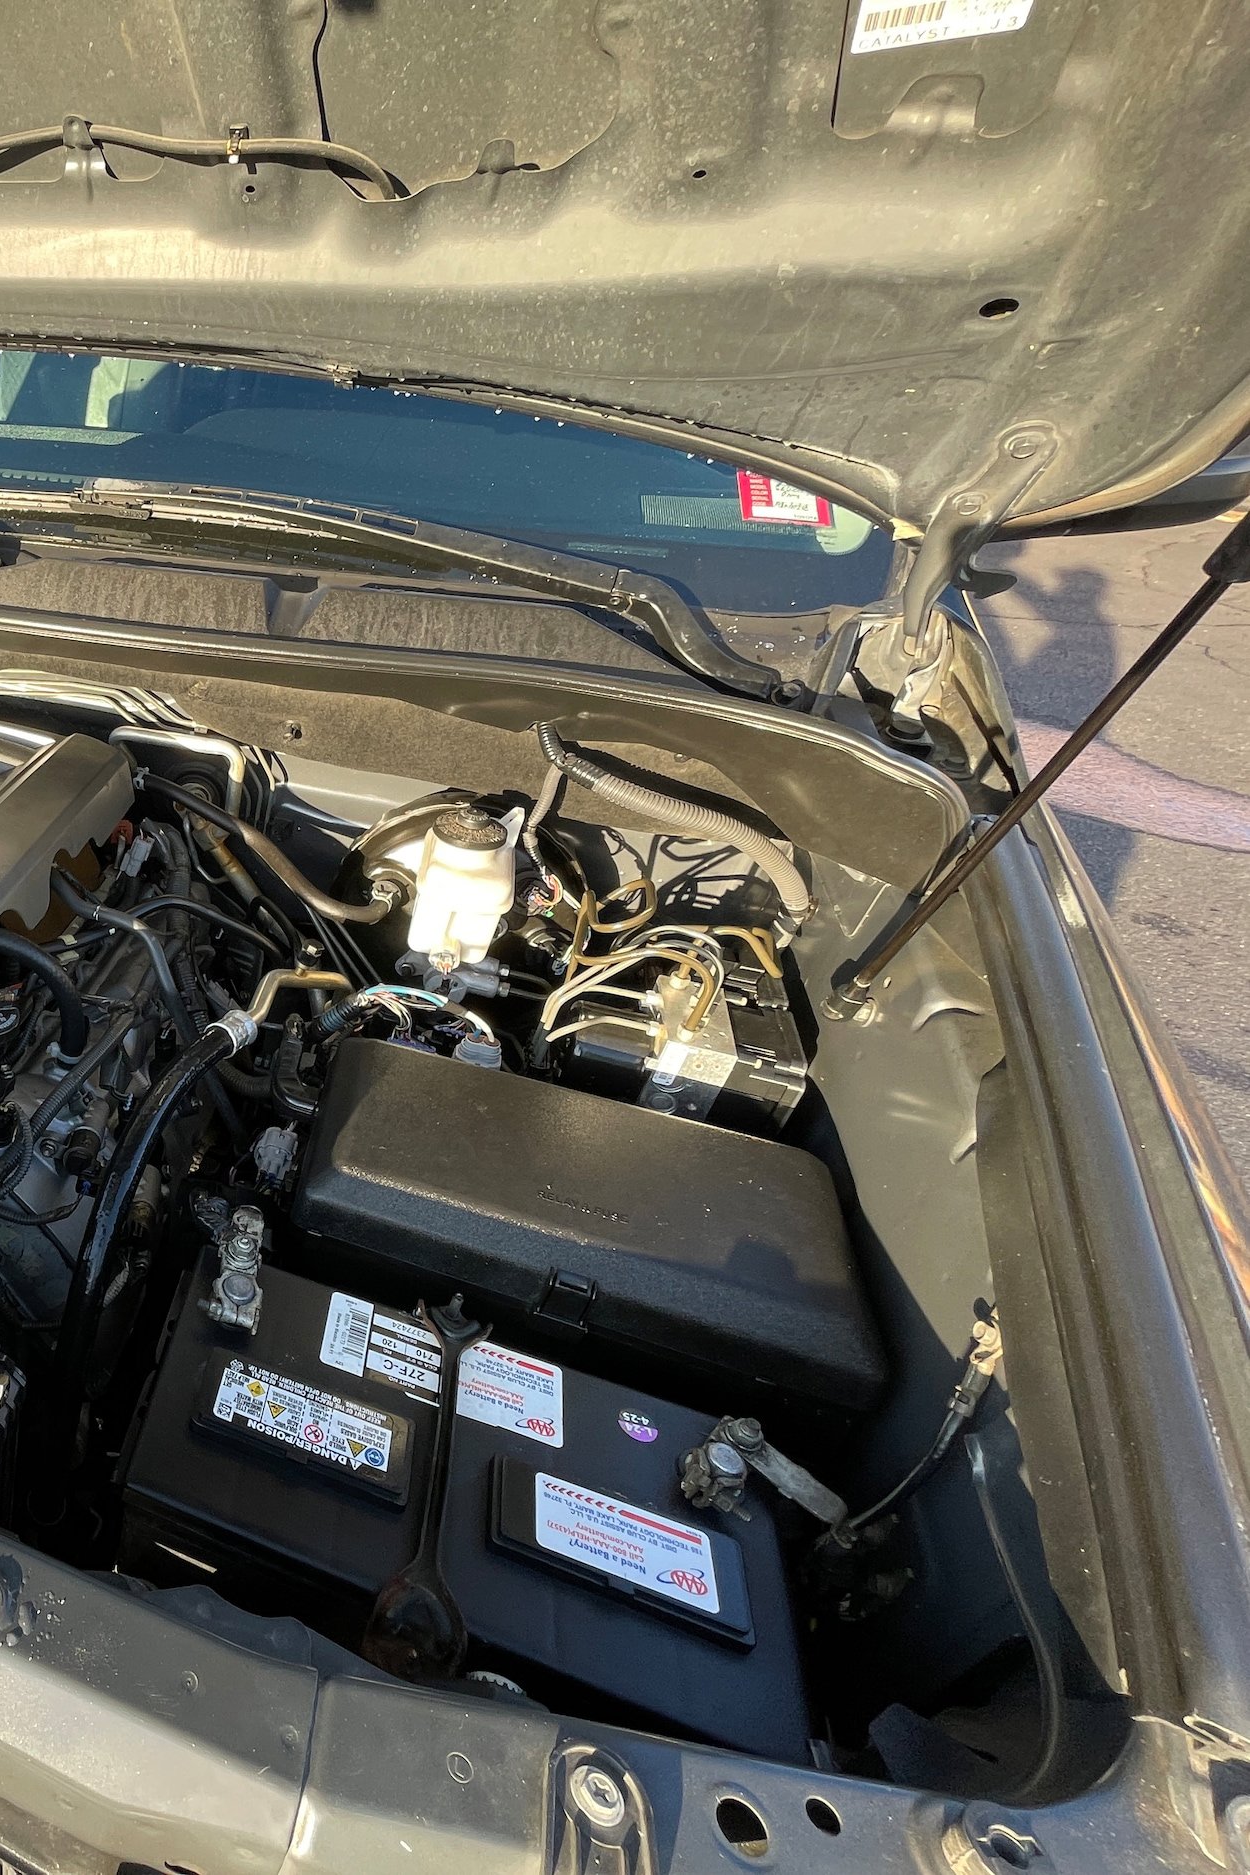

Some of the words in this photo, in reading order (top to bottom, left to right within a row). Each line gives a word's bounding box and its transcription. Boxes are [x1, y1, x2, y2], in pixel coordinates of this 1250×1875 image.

[859, 26, 950, 50] CATALYST
[391, 1320, 426, 1339] 2377424
[381, 1337, 398, 1349] 120
[395, 1332, 417, 1344] SERIAL
[415, 1348, 433, 1361] 710
[382, 1357, 425, 1382] 27F-C
[423, 1362, 437, 1371] CCA
[495, 1367, 540, 1386] TECHNOLOGY
[535, 1375, 553, 1386] LAKE
[464, 1387, 495, 1404] Battery?
[470, 1377, 523, 1400] AAA.com/battery
[504, 1402, 523, 1414] Need
[511, 1398, 523, 1406] Call
[530, 1418, 550, 1437] AAA
[246, 1418, 347, 1465] DANGER/POISON
[564, 1498, 571, 1507] FL
[596, 1510, 614, 1523] LAKE
[600, 1519, 624, 1533] ASSIST
[575, 1520, 643, 1554] AAA.com/battery
[626, 1528, 646, 1541] CLUB
[639, 1526, 689, 1551] TECHNOLOGY
[569, 1535, 608, 1560] Battery?
[611, 1553, 617, 1561] a
[628, 1550, 644, 1563] Call
[620, 1557, 645, 1574] Need
[674, 1568, 702, 1596] AAA
